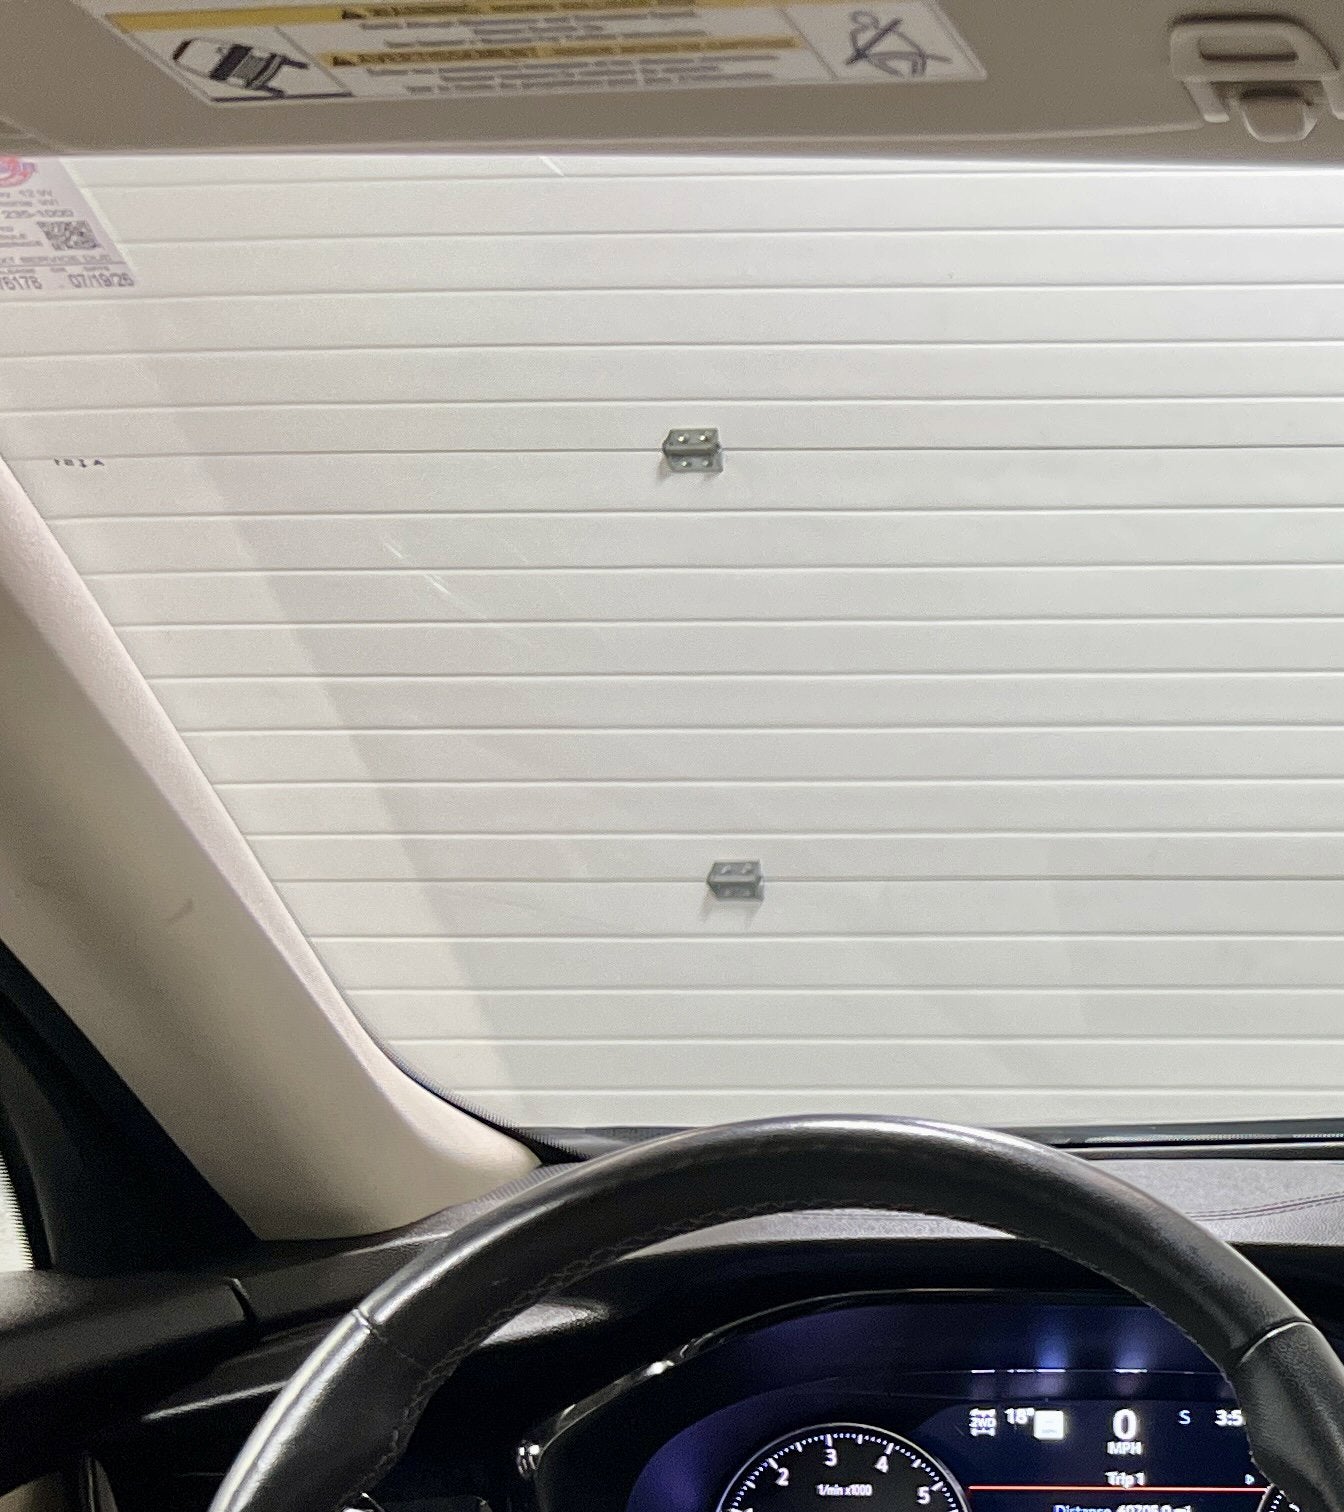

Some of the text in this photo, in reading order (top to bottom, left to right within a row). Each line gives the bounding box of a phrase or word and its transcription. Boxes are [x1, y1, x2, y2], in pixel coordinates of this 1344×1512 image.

[1112, 1408, 1138, 1441] 0
[1179, 1409, 1192, 1425] S
[824, 1448, 838, 1467] 3
[1107, 1441, 1143, 1455] MPH
[875, 1455, 890, 1474] 4
[775, 1467, 790, 1487] 2
[1105, 1471, 1146, 1488] Trip 1
[845, 1483, 873, 1497] x1000
[916, 1486, 931, 1505] 5
